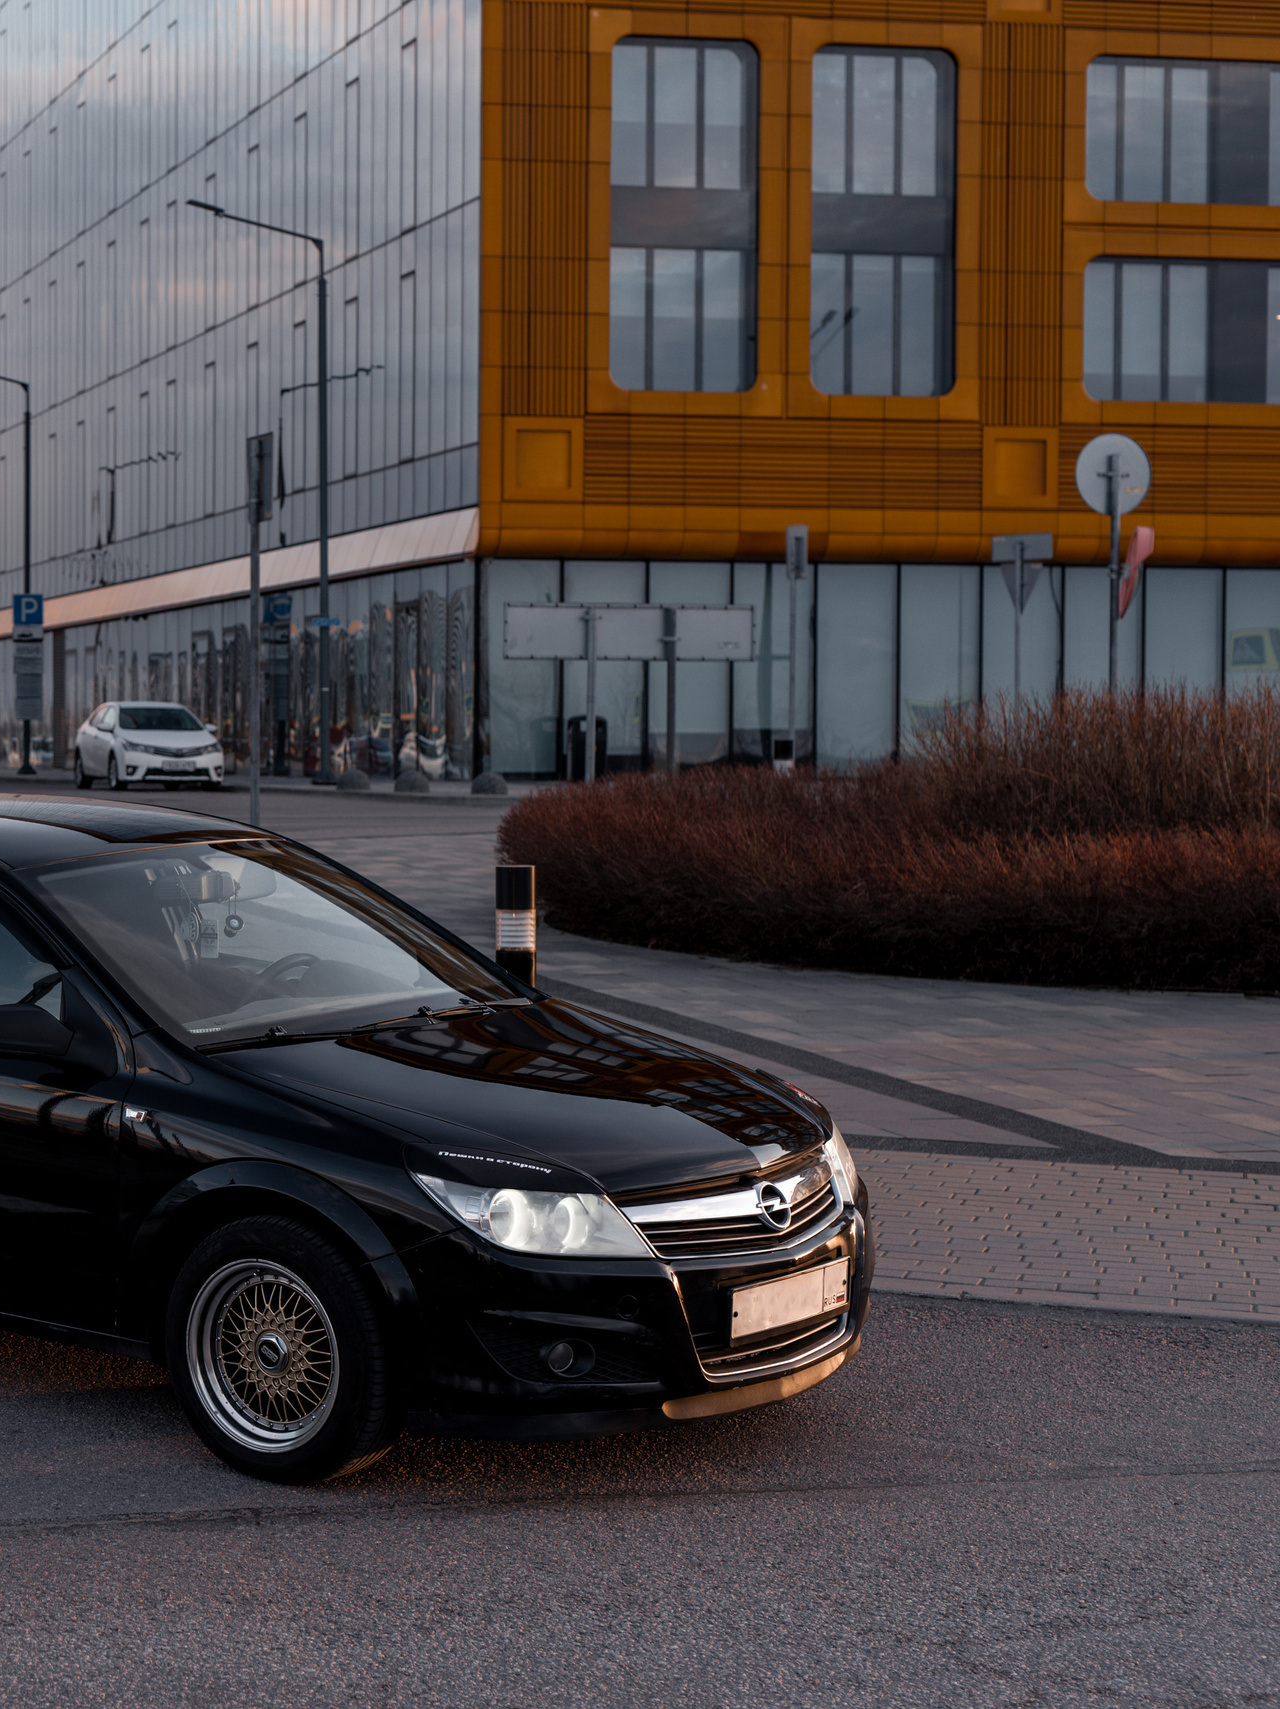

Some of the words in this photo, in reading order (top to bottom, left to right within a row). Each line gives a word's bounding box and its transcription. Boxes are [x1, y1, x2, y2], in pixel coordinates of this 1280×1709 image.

[21, 597, 39, 622] P
[438, 1151, 484, 1160] Пешки
[496, 1159, 552, 1174] сторону
[824, 1294, 836, 1306] RUS
[260, 1344, 279, 1363] BBS
